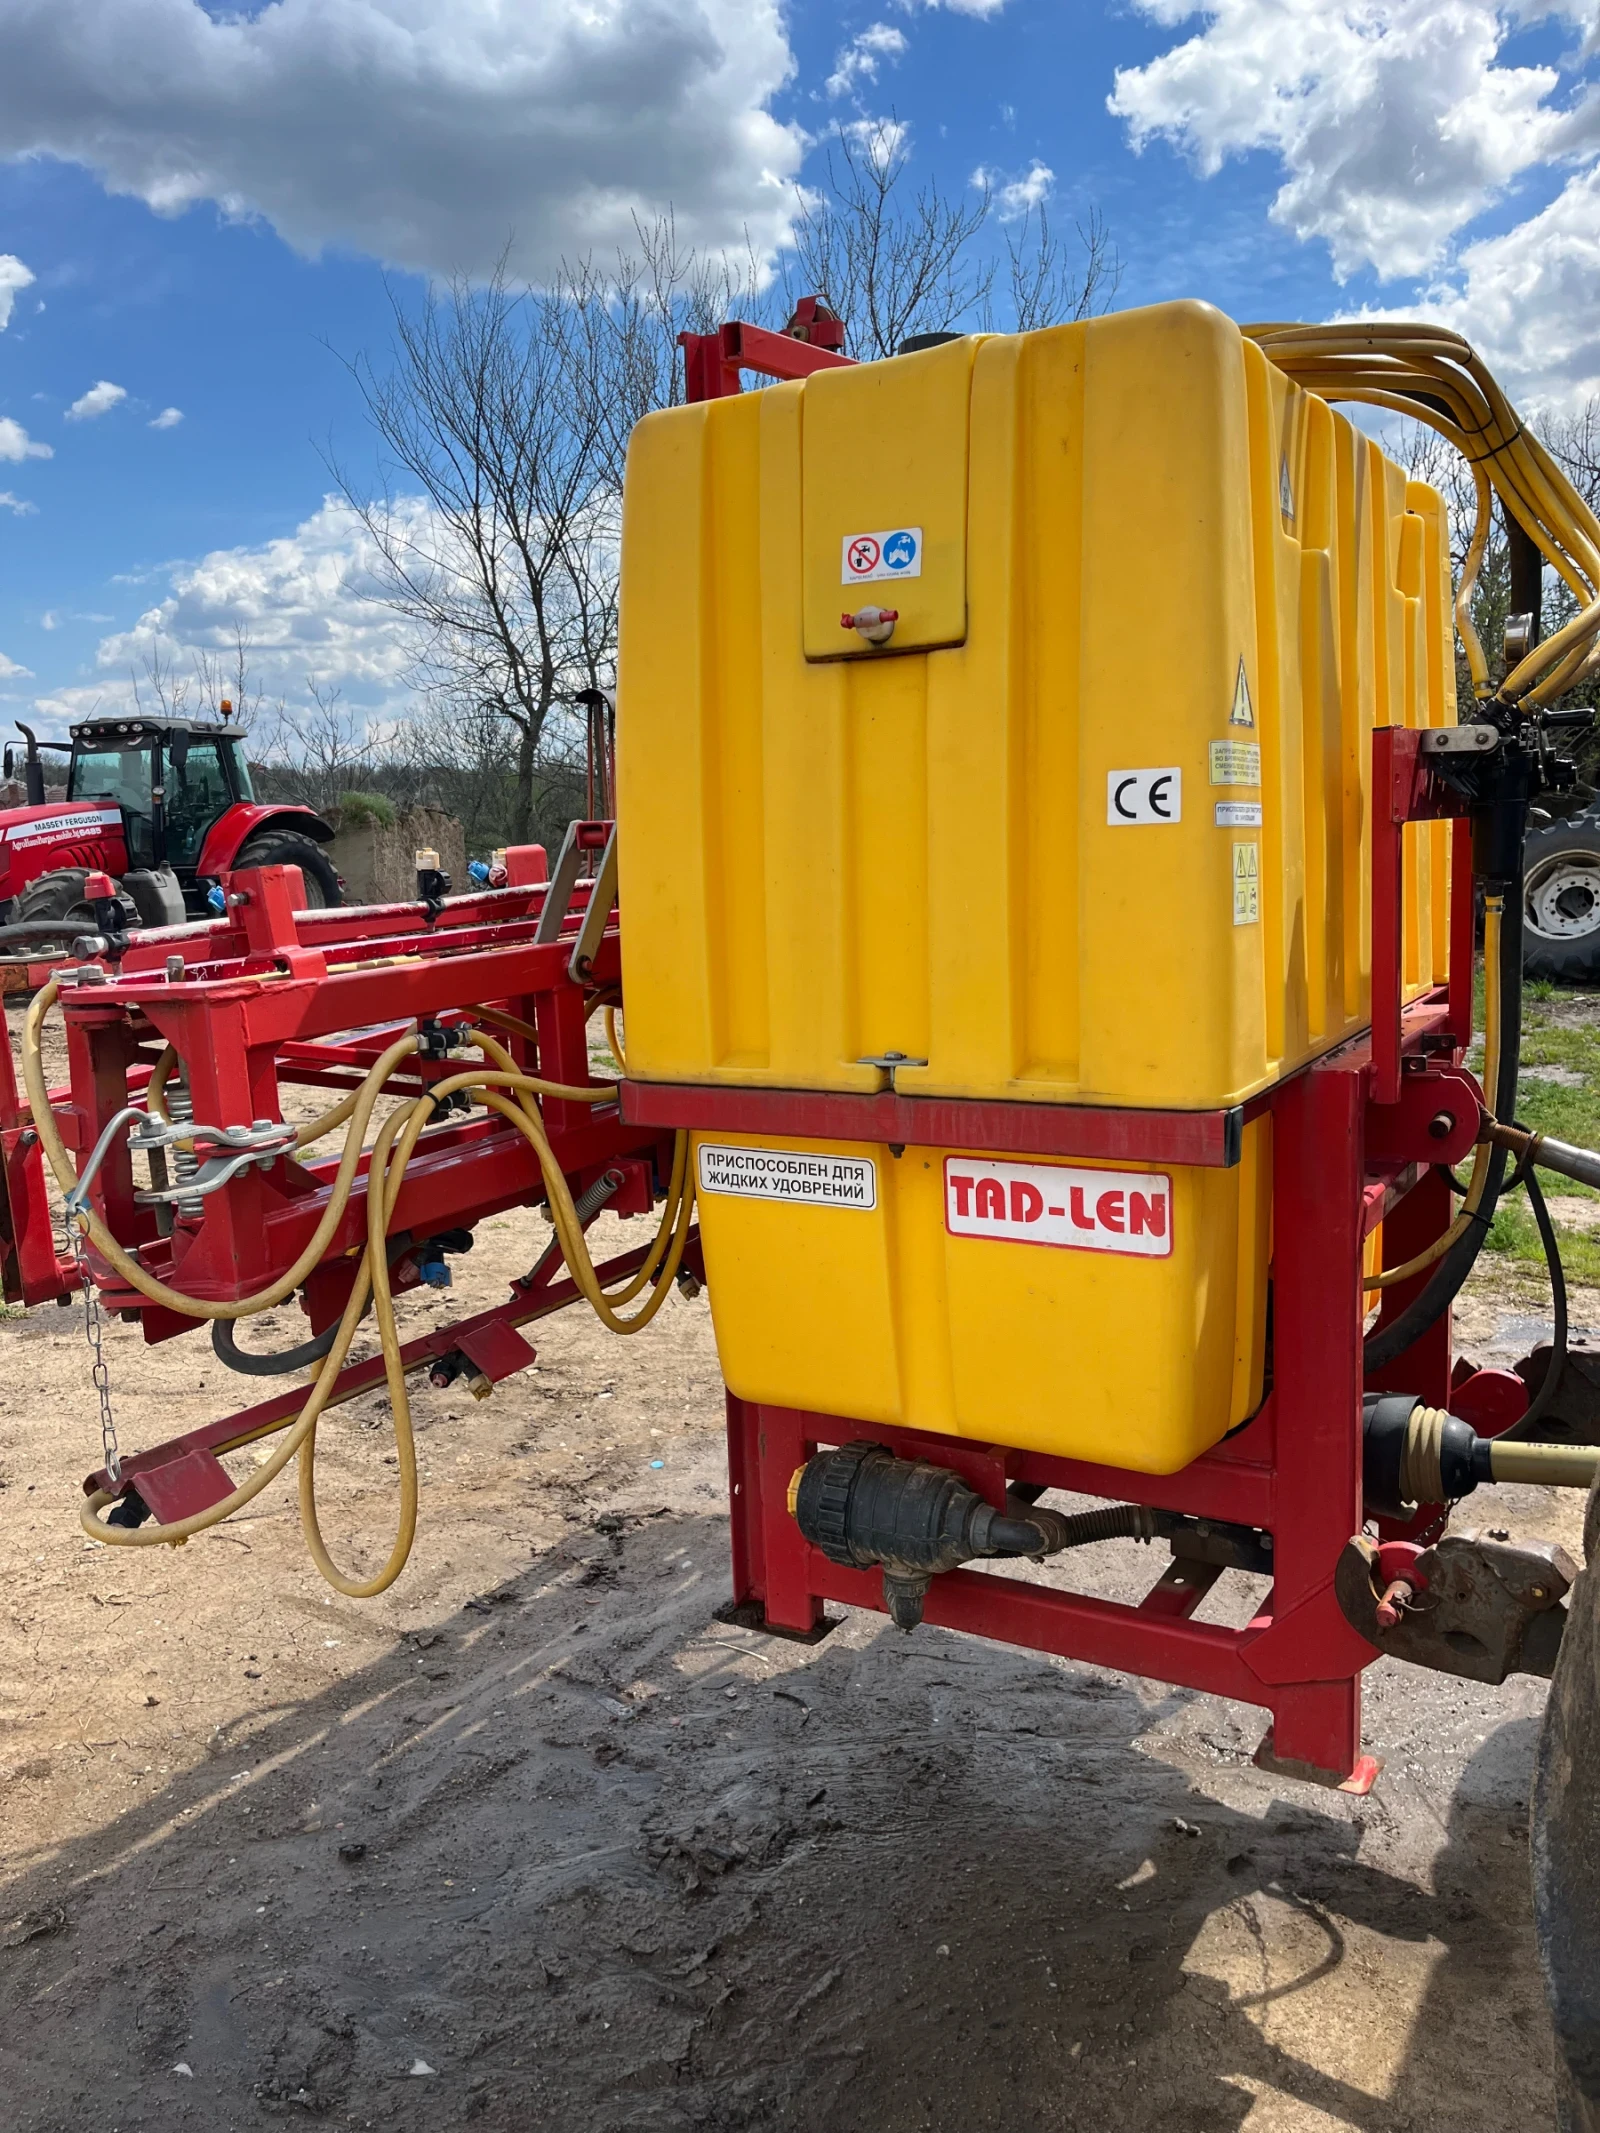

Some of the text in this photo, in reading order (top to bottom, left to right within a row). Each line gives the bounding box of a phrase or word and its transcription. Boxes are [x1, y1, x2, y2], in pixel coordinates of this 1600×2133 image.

[1114, 775, 1173, 819] CE
[34, 815, 103, 831] MASSEY FERGUSON
[79, 827, 102, 836] 6485
[707, 1153, 828, 1177] ПРИСПОСОБЛЕН
[708, 1170, 864, 1200] ЖИДКИХ УДОВРЕНИЙ
[949, 1175, 1166, 1238] TAD-LEN
